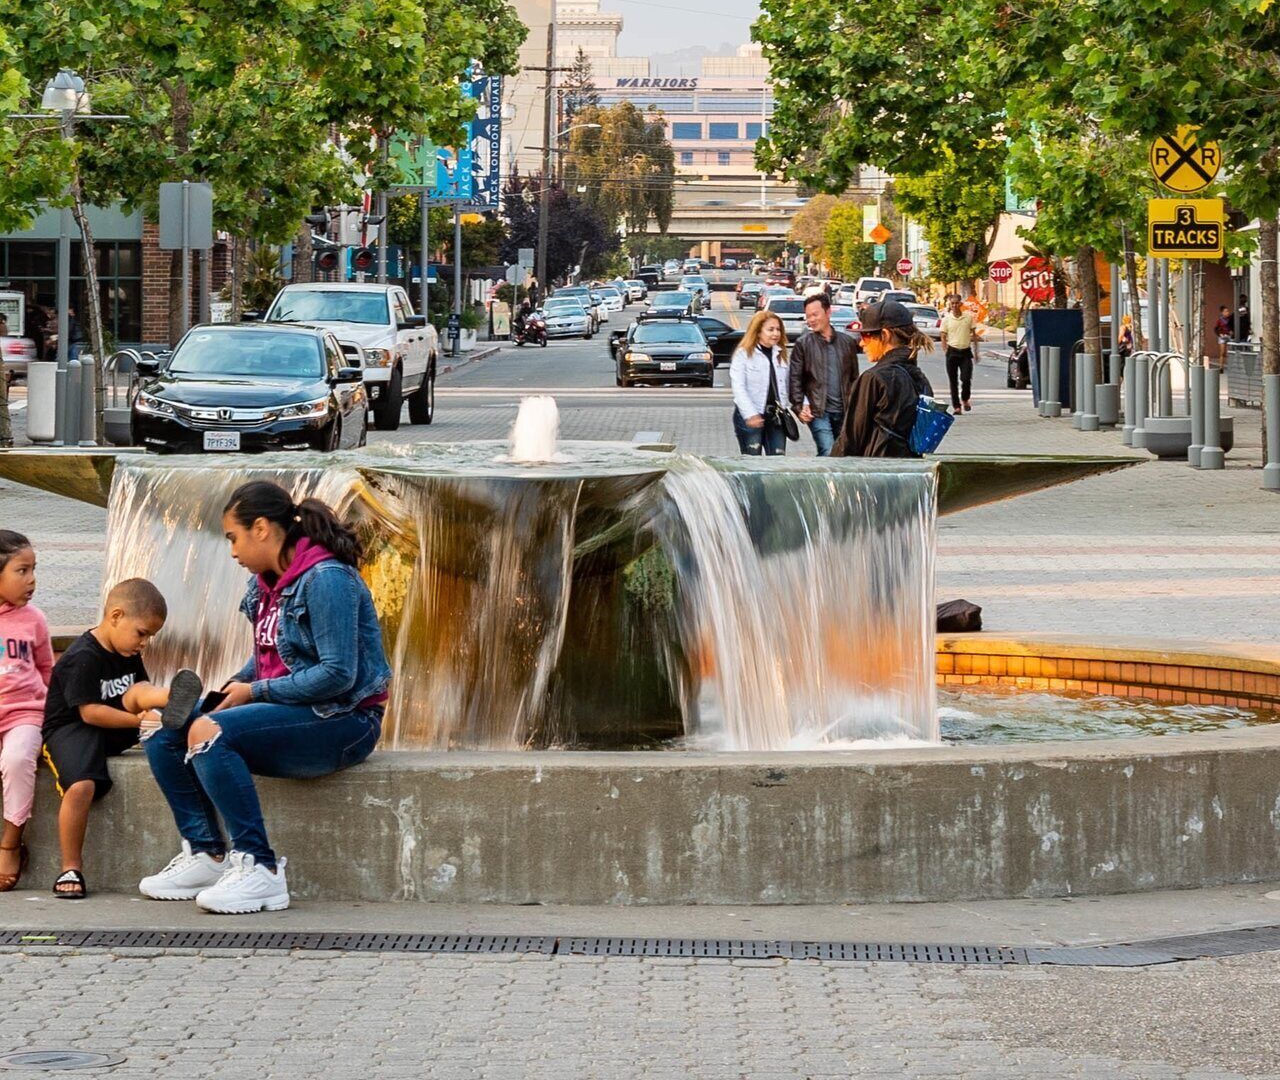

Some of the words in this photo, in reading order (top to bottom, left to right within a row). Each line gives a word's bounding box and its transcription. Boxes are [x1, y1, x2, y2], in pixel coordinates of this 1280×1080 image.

[616, 77, 698, 88] WARRIORS
[491, 74, 500, 119] SQUARE
[490, 124, 499, 173] LONDON
[1155, 148, 1170, 166] R
[1201, 148, 1216, 166] R
[425, 150, 435, 185] JACK
[461, 167, 470, 197] JACK
[490, 178, 498, 206] JACK
[1180, 209, 1191, 226] 3
[1154, 230, 1217, 245] TRACKS
[898, 262, 913, 271] STOP
[990, 267, 1012, 278] STOP
